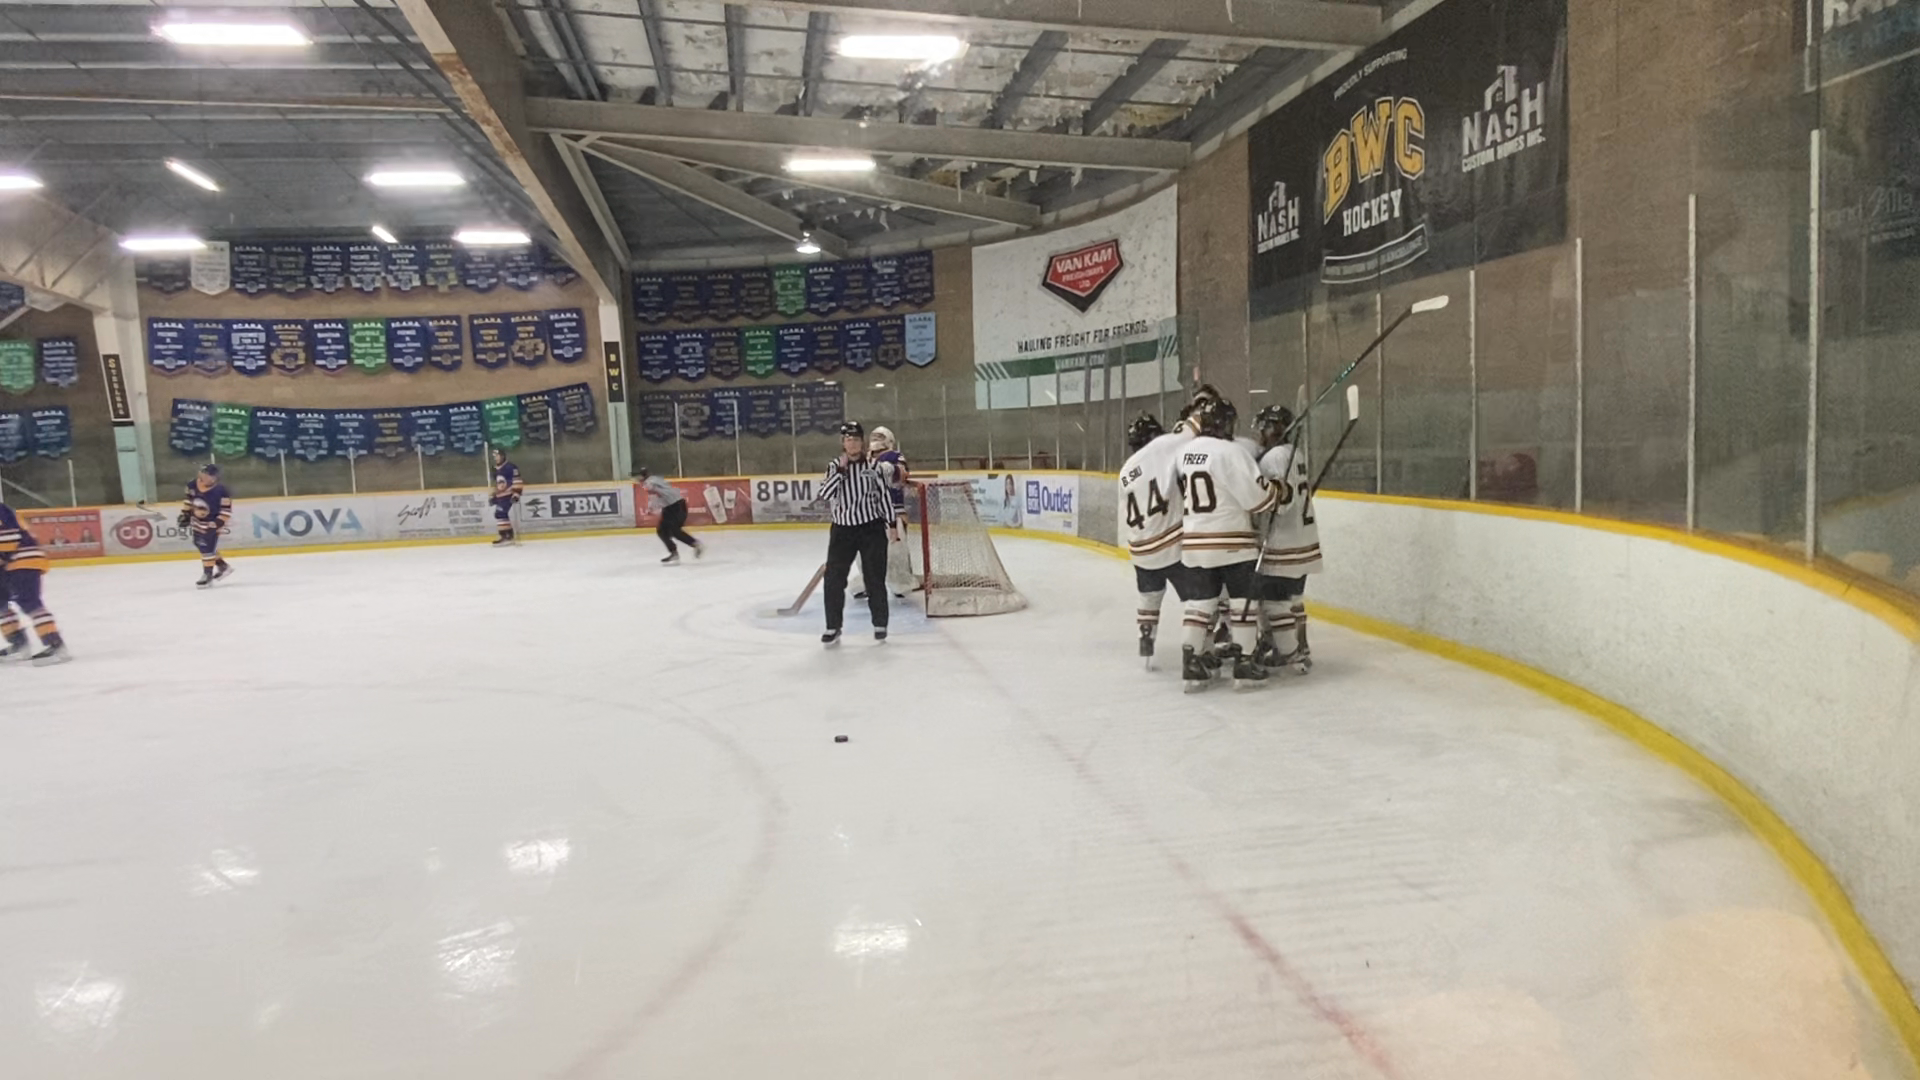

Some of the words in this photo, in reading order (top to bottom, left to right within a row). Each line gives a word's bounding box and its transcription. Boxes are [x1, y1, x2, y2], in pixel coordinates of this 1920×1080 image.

[1462, 81, 1546, 157] NASH
[1323, 96, 1425, 225] BWC
[1257, 196, 1300, 243] NASH
[1343, 188, 1402, 236] HOCKEY
[1055, 256, 1083, 273] VAN
[1083, 247, 1113, 267] KAM
[1017, 337, 1052, 354] HAULING
[1054, 330, 1092, 349] FREIGHT
[1093, 327, 1111, 344] FOR
[1183, 453, 1209, 465] FREER
[756, 479, 812, 503] 8PM
[1041, 485, 1073, 513] Outlet
[1126, 477, 1170, 530] 44
[560, 496, 611, 516] FBM
[156, 525, 232, 541] Logis
[252, 507, 364, 539] NOVA
